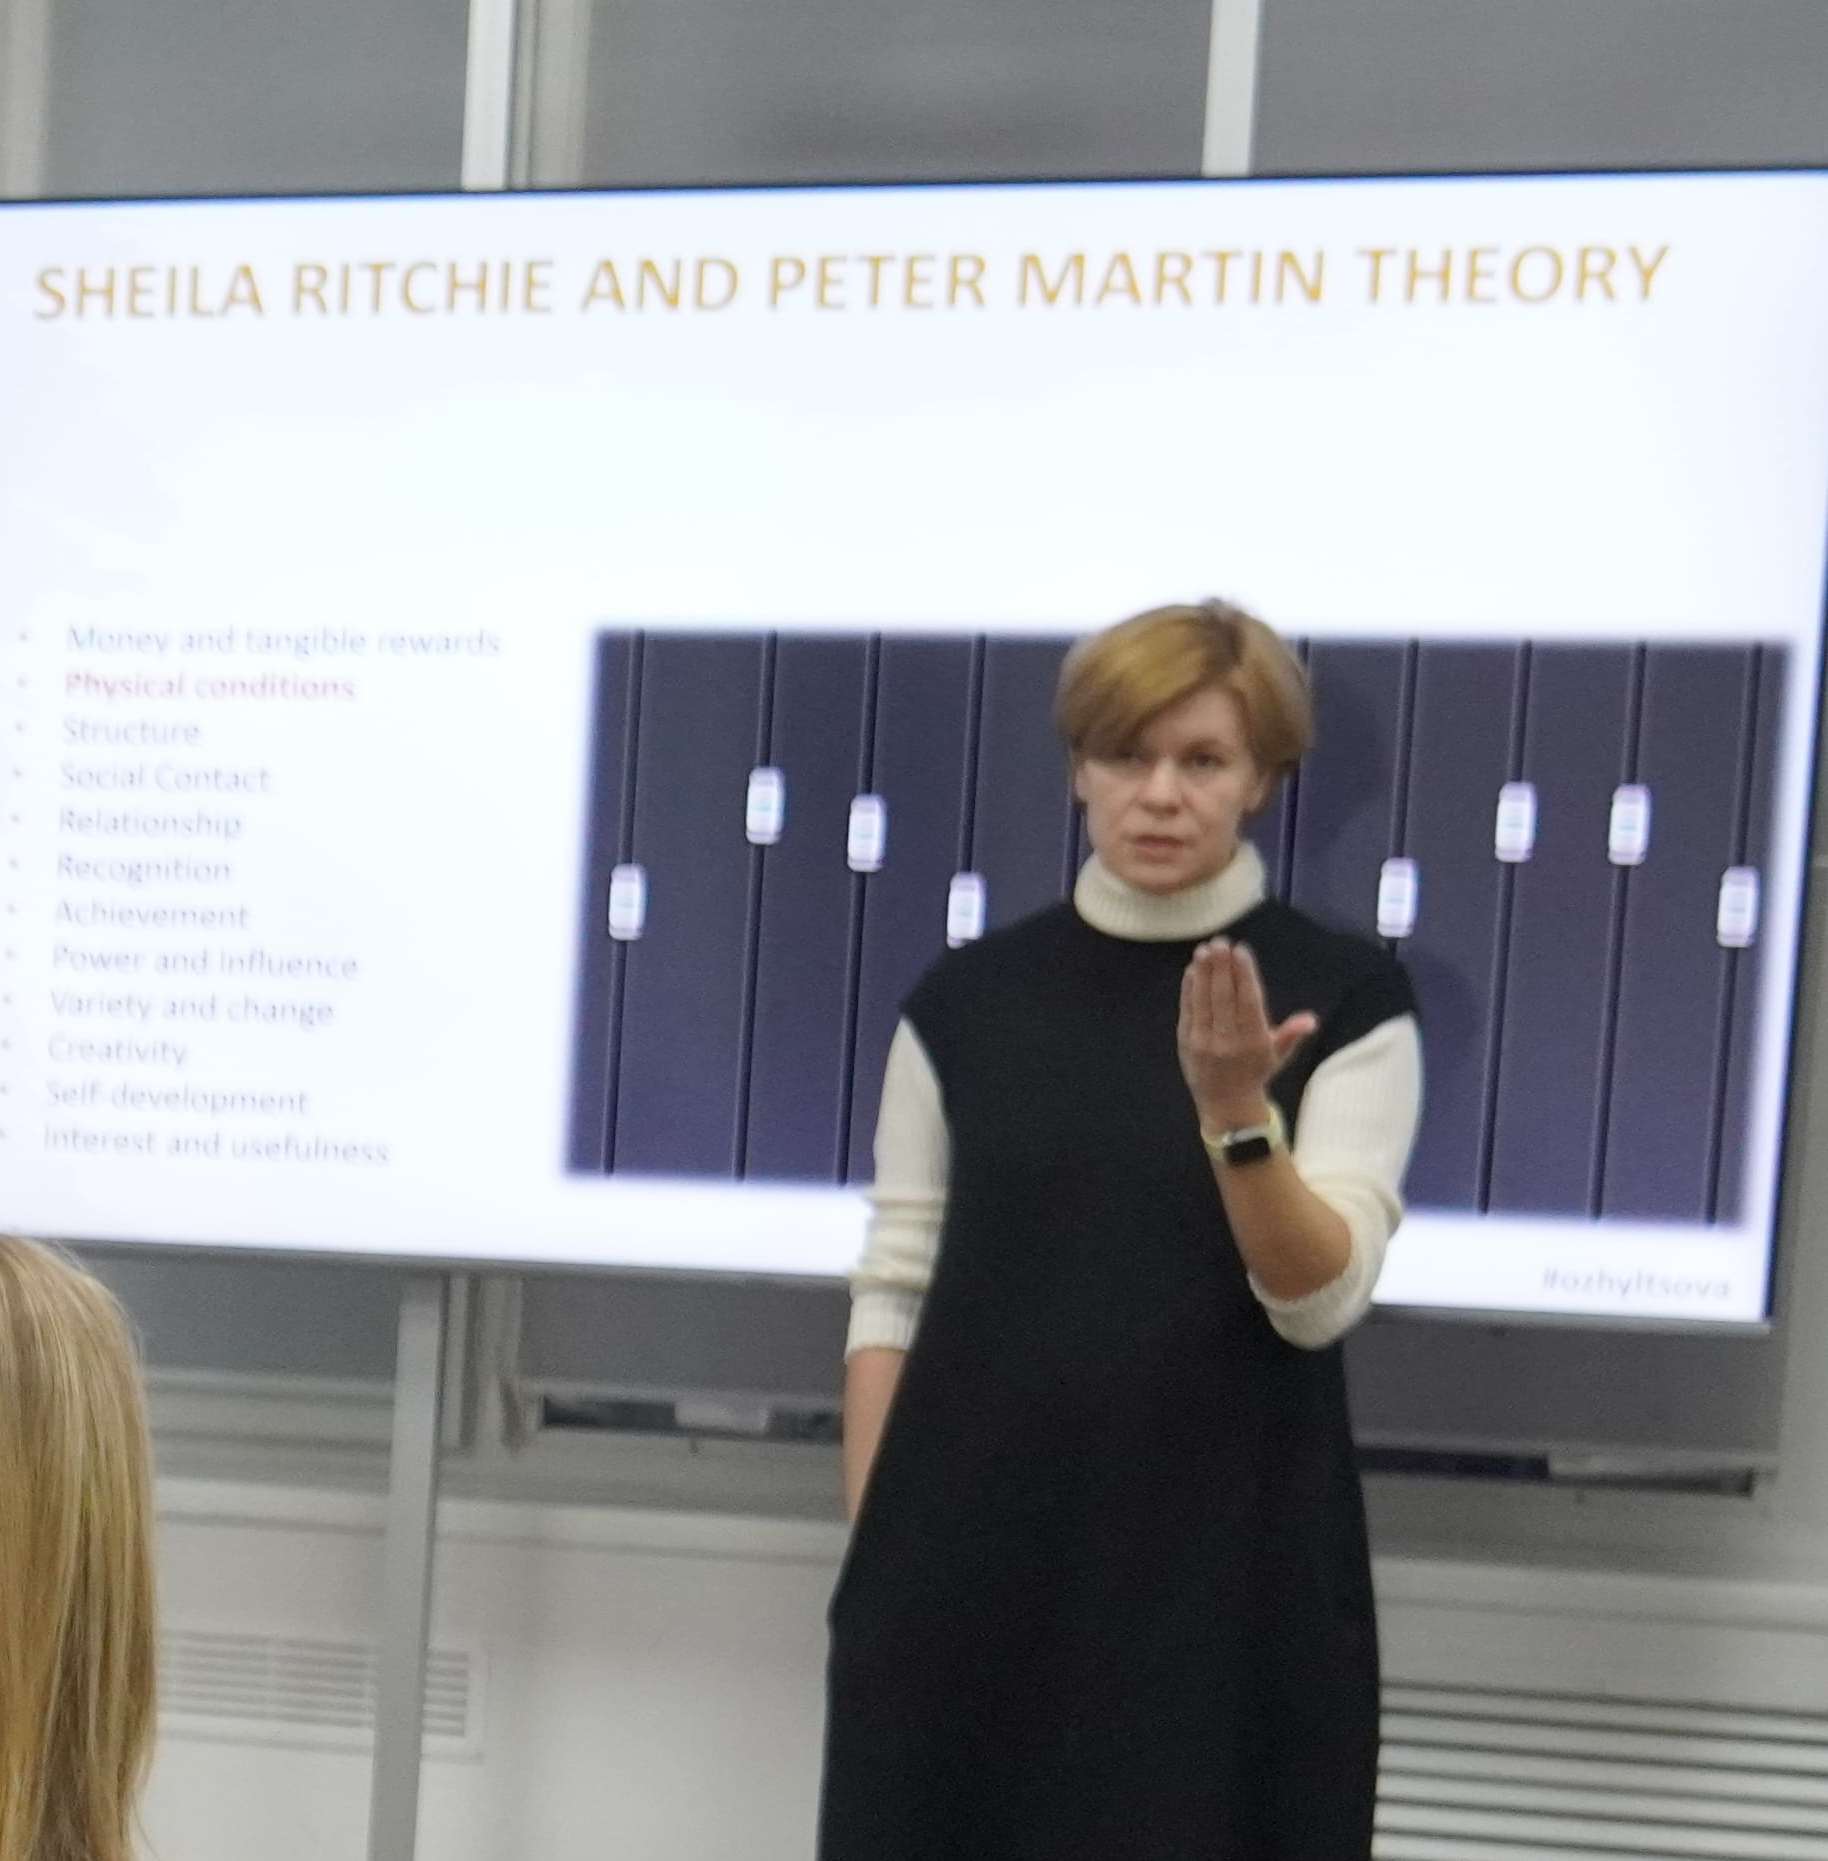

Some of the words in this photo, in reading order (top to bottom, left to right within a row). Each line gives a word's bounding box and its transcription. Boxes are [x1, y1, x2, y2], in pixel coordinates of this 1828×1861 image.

[34, 265, 264, 320] SHEILA
[292, 259, 553, 317] RITCHIE
[580, 256, 738, 313] AND
[769, 252, 987, 310] PETER
[1019, 249, 1325, 307] MARTIN
[1355, 244, 1671, 305] THEORY
[66, 625, 169, 658] Money
[180, 626, 234, 655] and
[245, 626, 366, 658] tangible
[378, 627, 502, 657] rewards
[66, 671, 184, 702] Physical
[195, 672, 356, 700] conditions
[62, 716, 200, 745] Structure
[61, 762, 144, 791] Social
[155, 763, 271, 793] Contact
[58, 808, 243, 841] Relationship
[57, 852, 232, 887] Recognition
[54, 900, 249, 929] Achievement
[53, 945, 143, 973] Power
[155, 946, 208, 975] and
[50, 989, 151, 1023] Variety
[162, 993, 216, 1021] and
[228, 995, 334, 1030] change
[48, 1034, 188, 1068] Creativity
[47, 1080, 309, 1117] Self-development
[43, 1125, 154, 1156] Interest
[167, 1129, 220, 1159] and
[232, 1131, 391, 1165] usefulness
